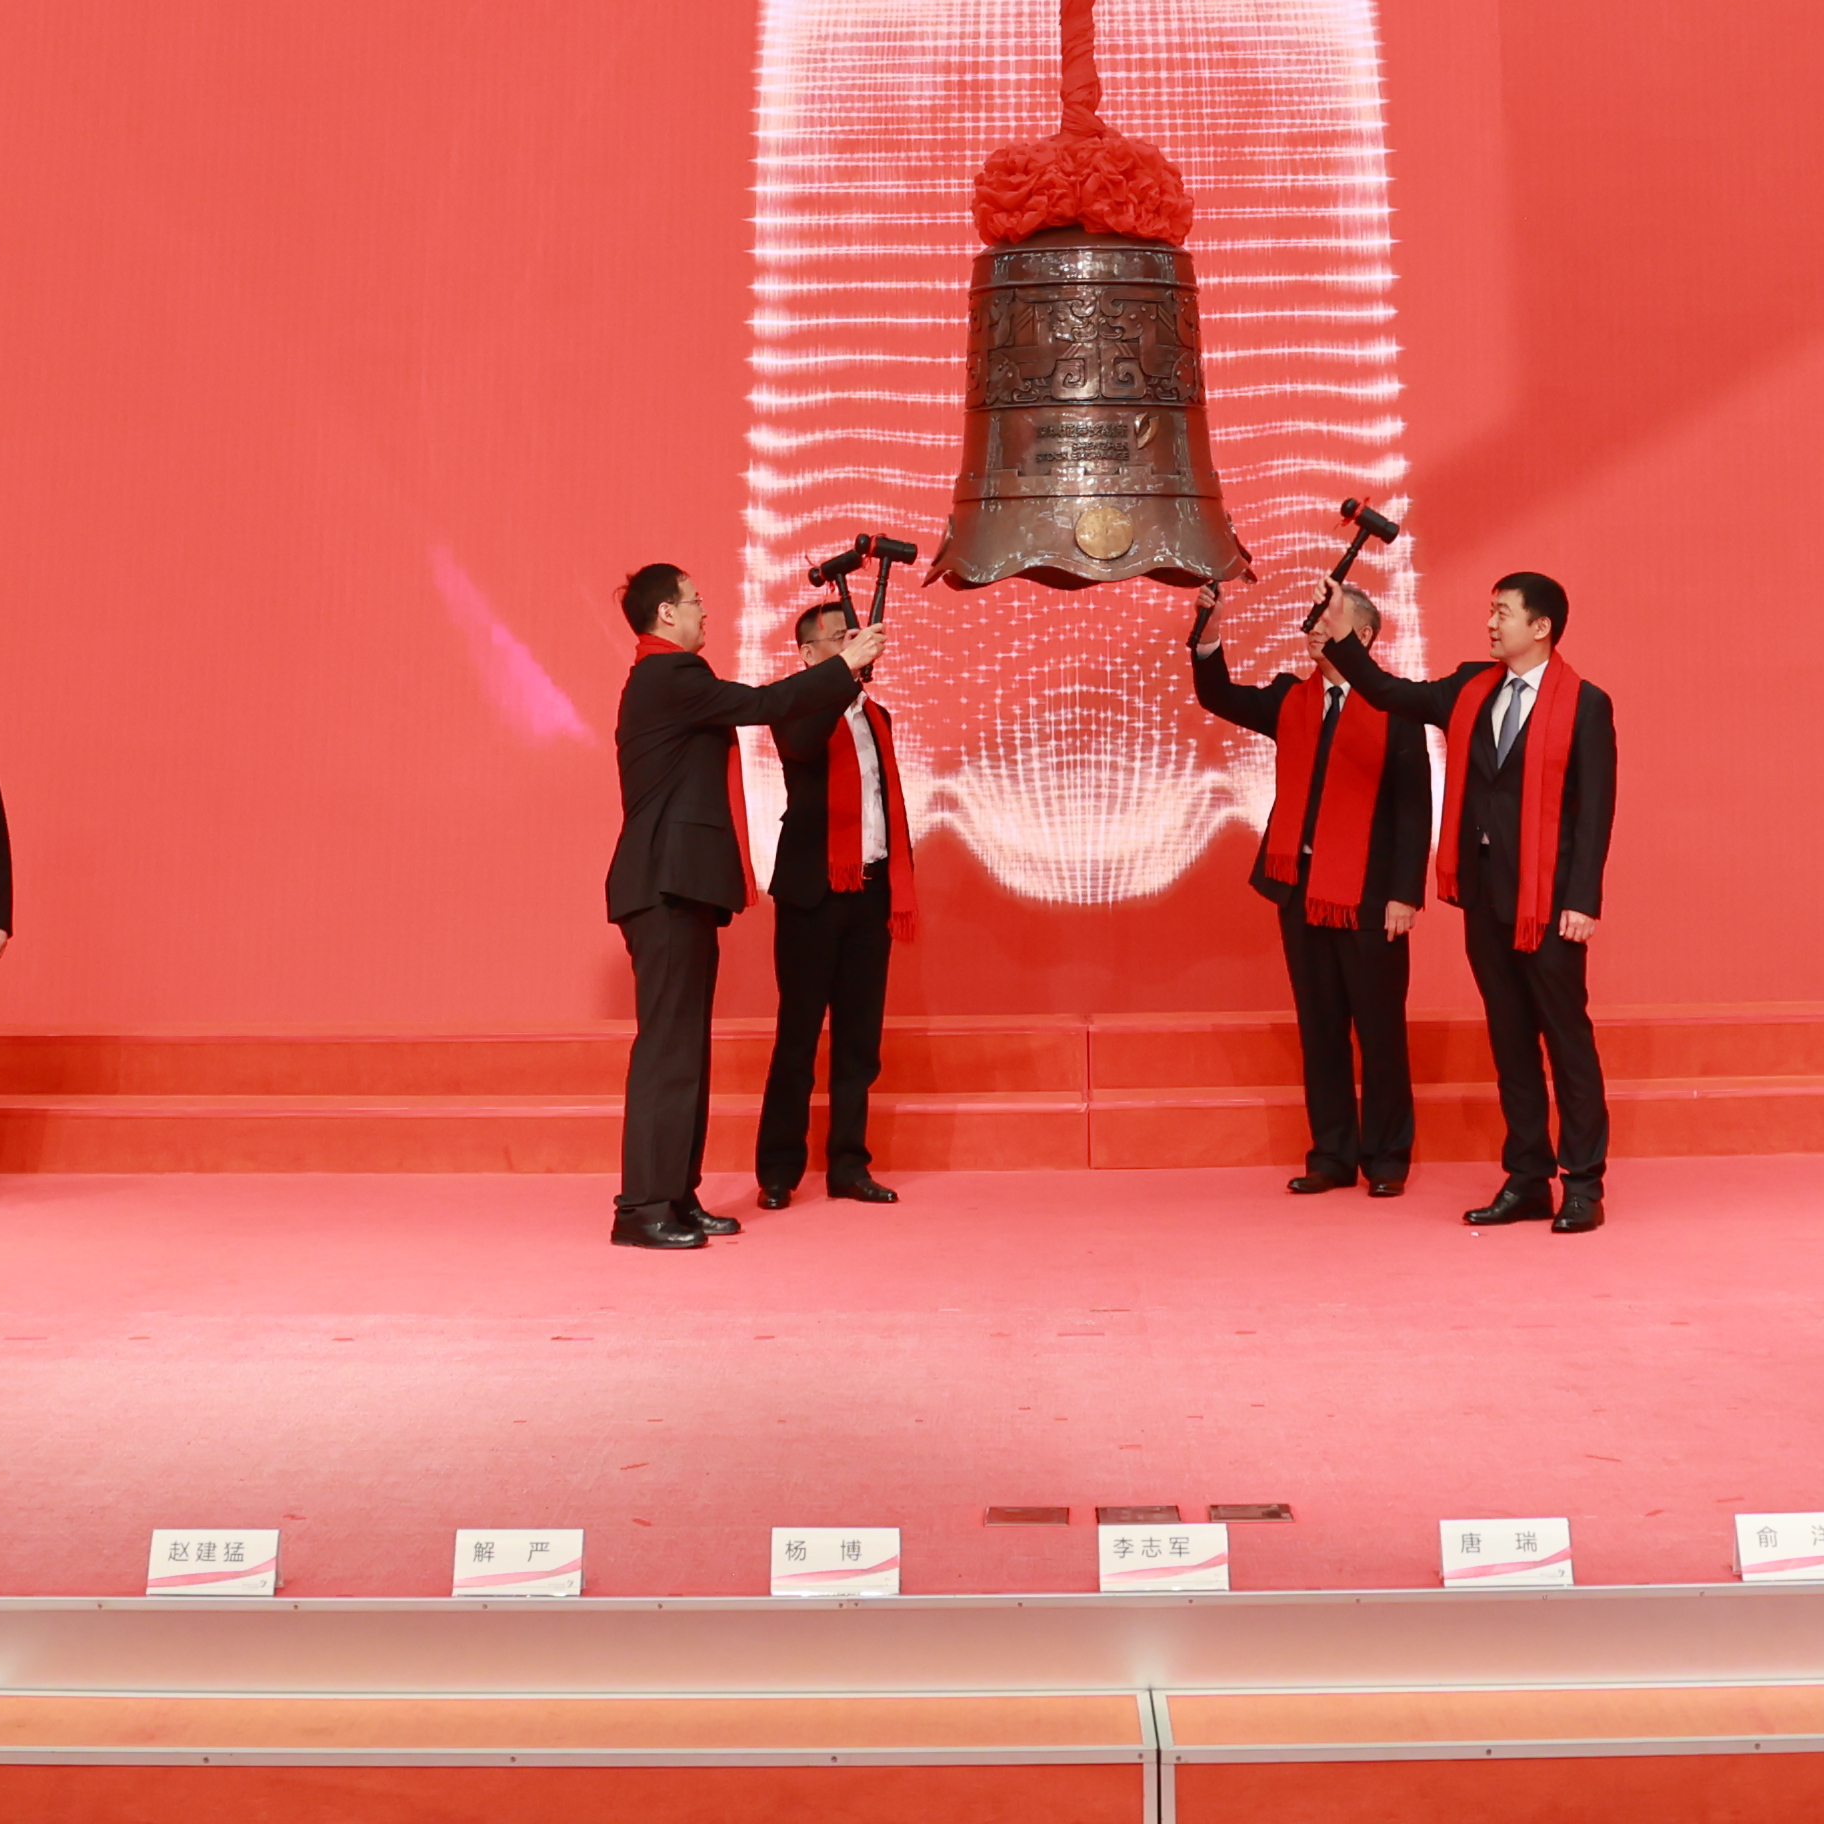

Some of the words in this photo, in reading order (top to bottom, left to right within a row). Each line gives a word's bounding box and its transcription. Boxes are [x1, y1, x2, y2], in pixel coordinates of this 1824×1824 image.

[167, 1540, 245, 1562] 赵建猛
[1113, 1536, 1190, 1558] 李志军
